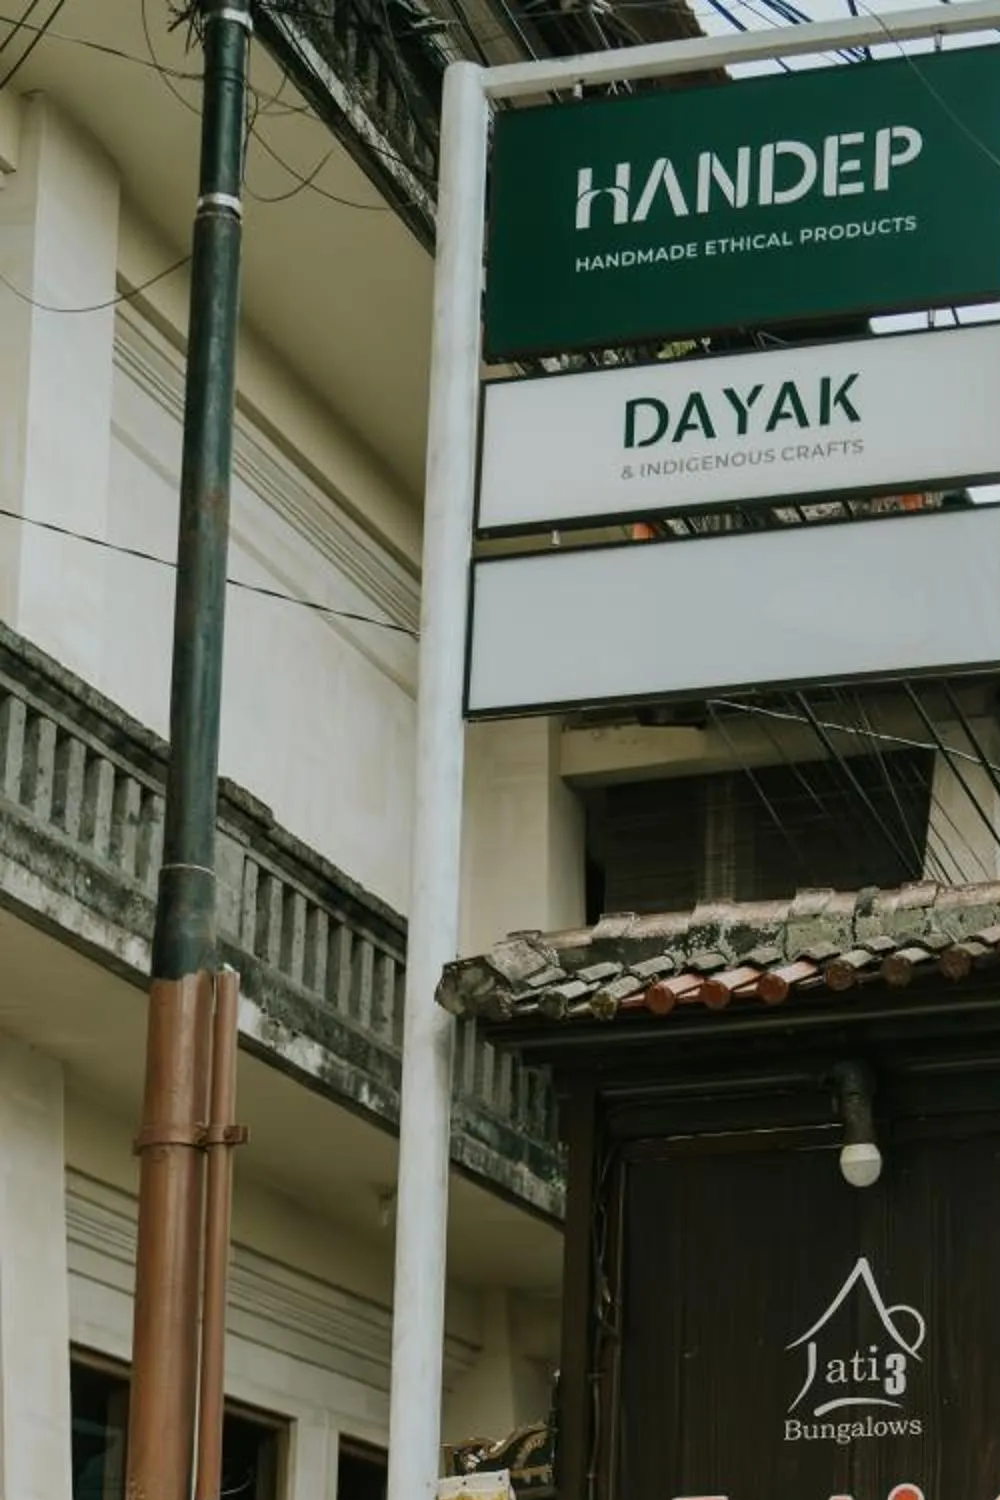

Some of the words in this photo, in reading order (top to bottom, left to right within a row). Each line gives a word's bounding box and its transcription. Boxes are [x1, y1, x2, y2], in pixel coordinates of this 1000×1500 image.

[576, 126, 922, 229] HANDEP
[576, 243, 698, 272] HANDMADE
[705, 232, 793, 256] ETHICAL
[800, 216, 917, 244] PRODUCTS
[624, 373, 861, 448] DAYAK
[621, 465, 635, 480] &
[640, 448, 776, 478] INDIGENOUS
[781, 439, 865, 462] CRAFTS
[784, 1416, 923, 1445] Bungalows
